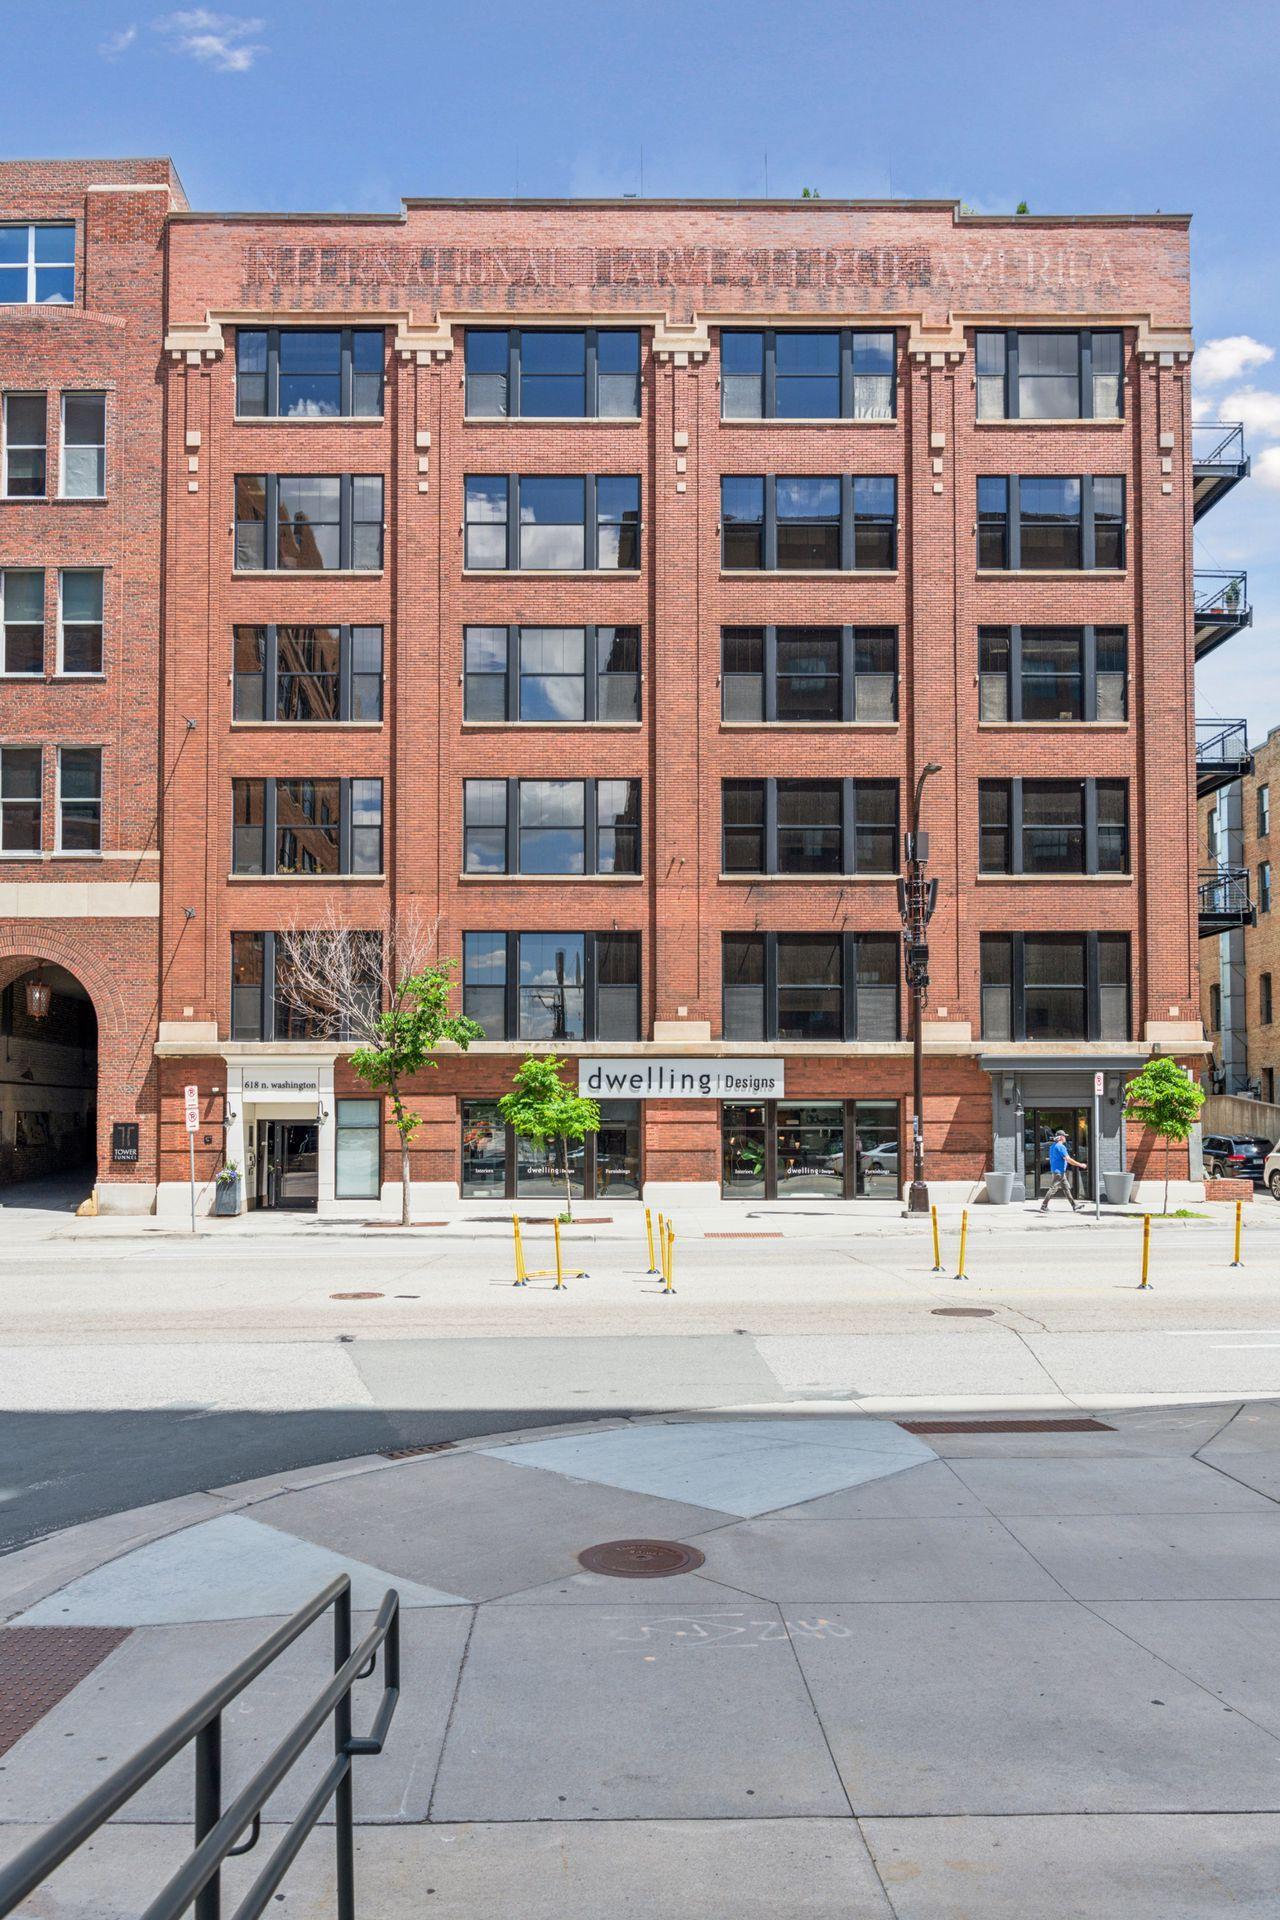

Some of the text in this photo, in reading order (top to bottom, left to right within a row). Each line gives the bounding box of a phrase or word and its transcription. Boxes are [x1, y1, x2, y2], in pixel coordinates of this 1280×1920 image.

[588, 1066, 775, 1094] dwelling Designs
[244, 1080, 259, 1089] 618
[271, 1080, 317, 1091] washington
[527, 1166, 560, 1175] dwelling
[787, 1166, 819, 1176] dwelling
